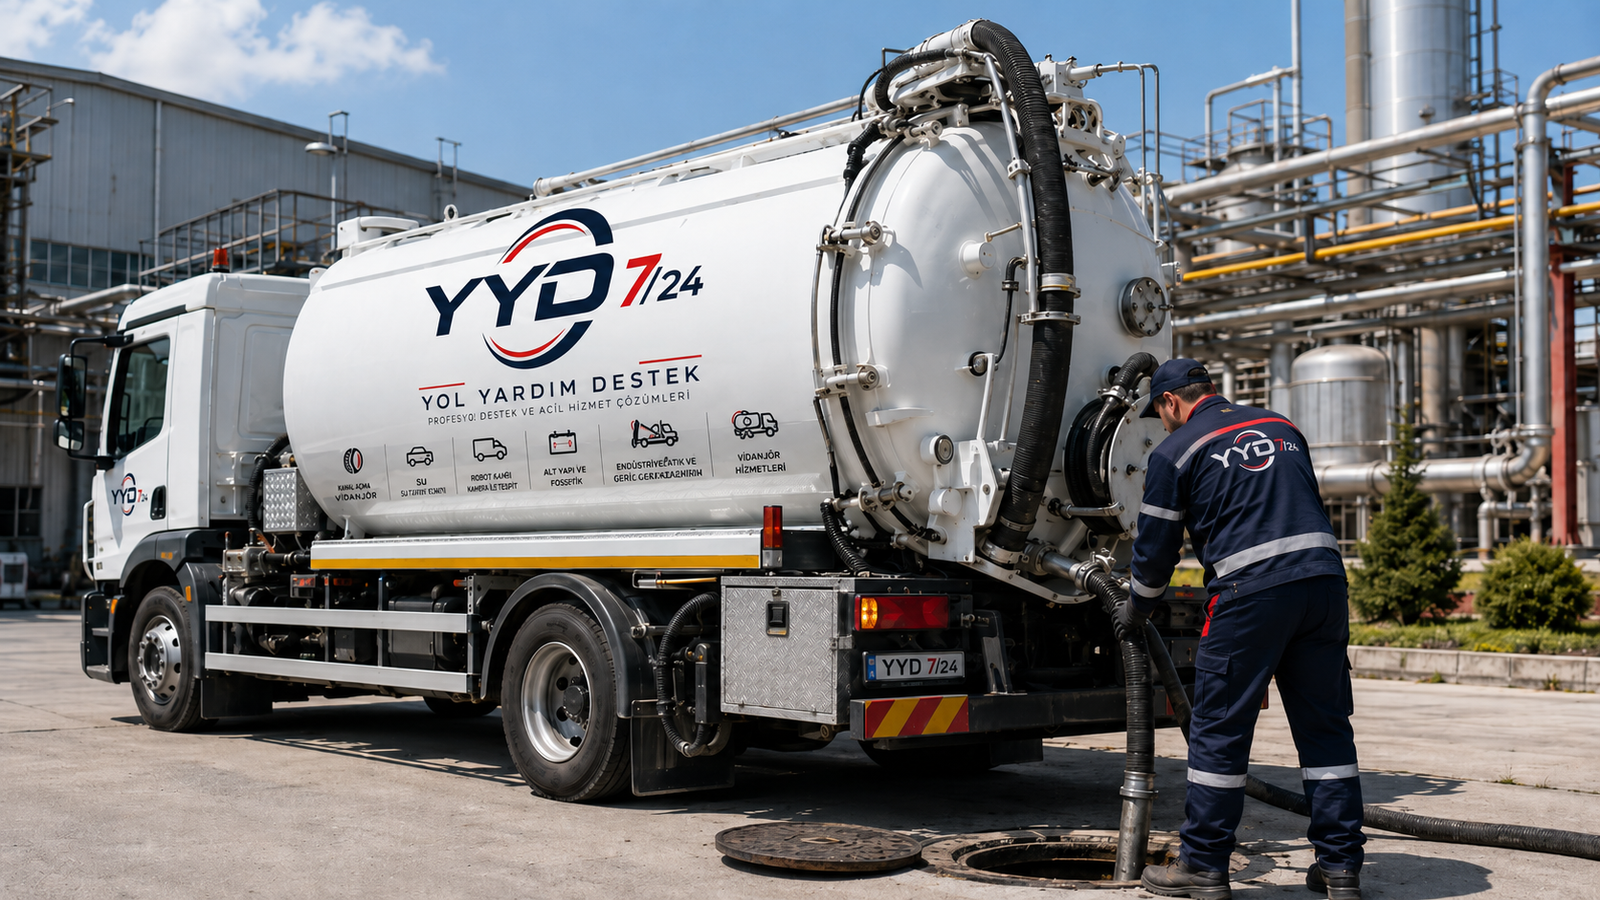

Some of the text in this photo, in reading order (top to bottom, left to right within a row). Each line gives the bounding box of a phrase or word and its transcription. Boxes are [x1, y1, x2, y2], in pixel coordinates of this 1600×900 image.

[425, 253, 704, 337] YYD 7/24
[421, 365, 700, 411] YOL YARDIM DESTEK
[480, 409, 518, 421] DESTEK
[521, 406, 535, 416] VE
[568, 399, 612, 412] HİZMET
[616, 389, 690, 409] ÇÖZÜMLERİ
[686, 456, 697, 465] VE
[737, 450, 781, 461] VİDANJÖR
[1210, 438, 1276, 469] YYD
[543, 468, 557, 476] ALT
[576, 465, 587, 473] VE
[735, 462, 787, 474] HİZMETLERİ
[416, 478, 427, 486] SU
[111, 487, 137, 505] YYD
[882, 658, 922, 676] YYD
[926, 657, 958, 675] 7/24
